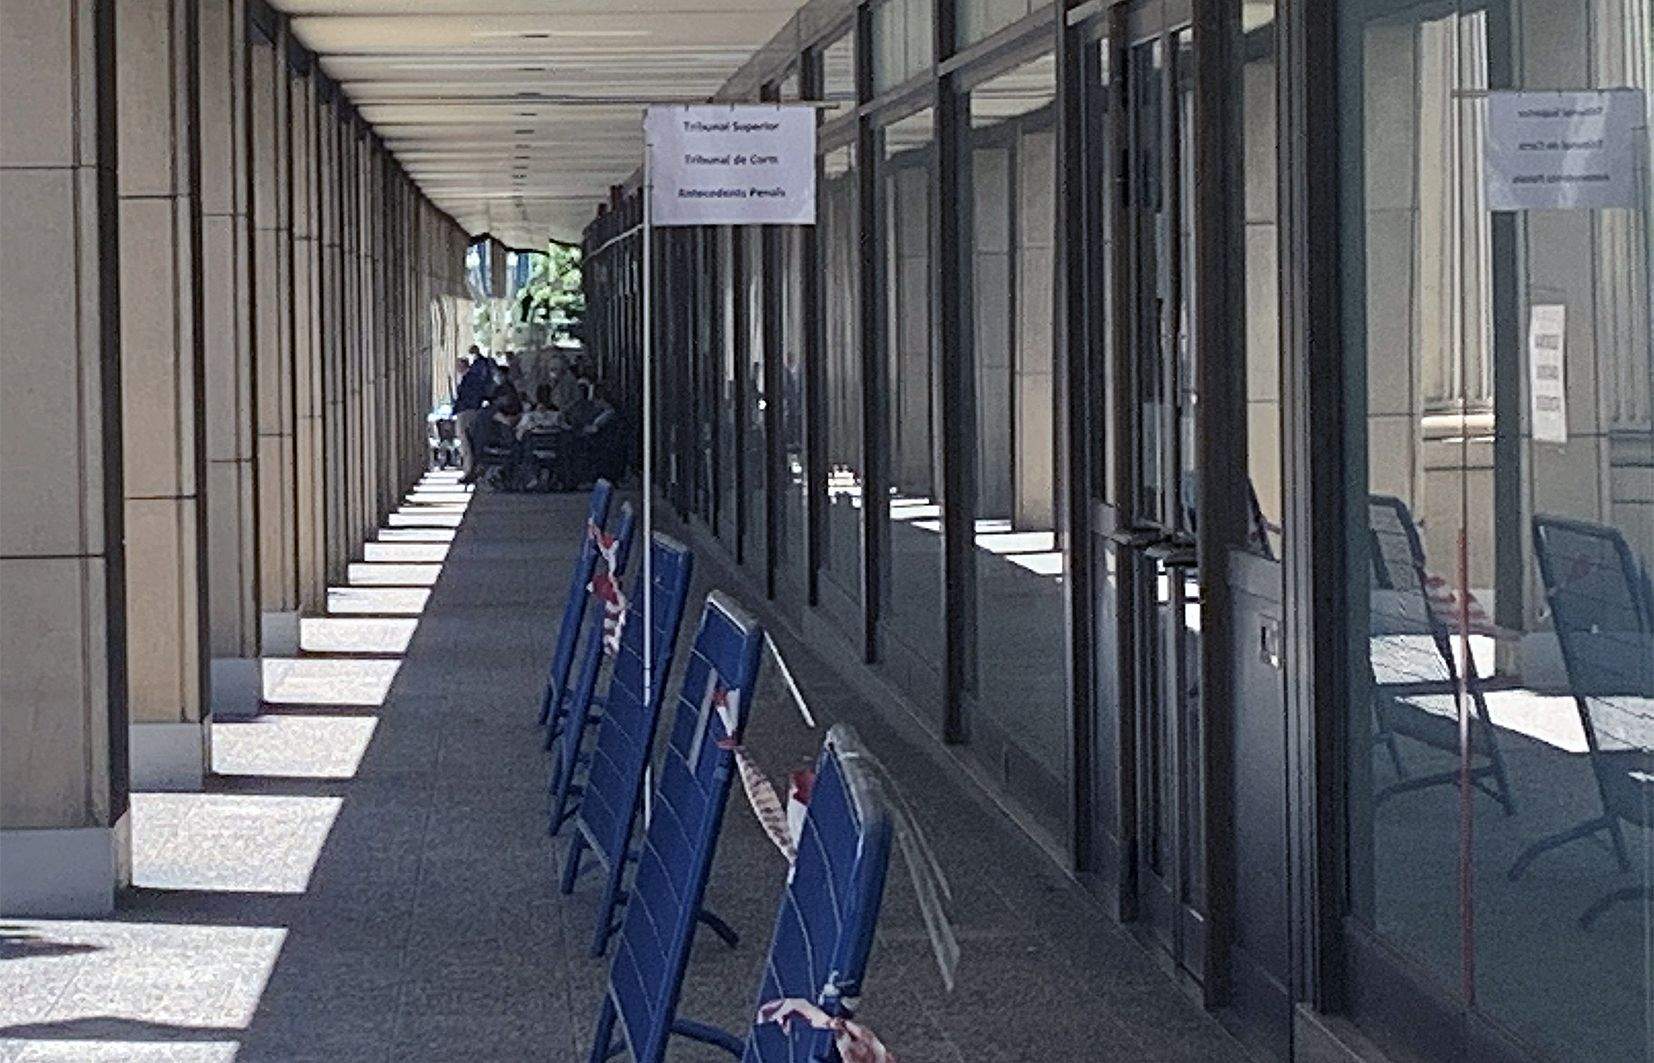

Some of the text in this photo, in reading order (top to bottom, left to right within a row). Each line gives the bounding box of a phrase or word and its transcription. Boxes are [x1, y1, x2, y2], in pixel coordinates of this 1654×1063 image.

[684, 121, 779, 132] Tribunal Superior
[684, 154, 730, 165] Tribunal
[733, 154, 746, 165] de
